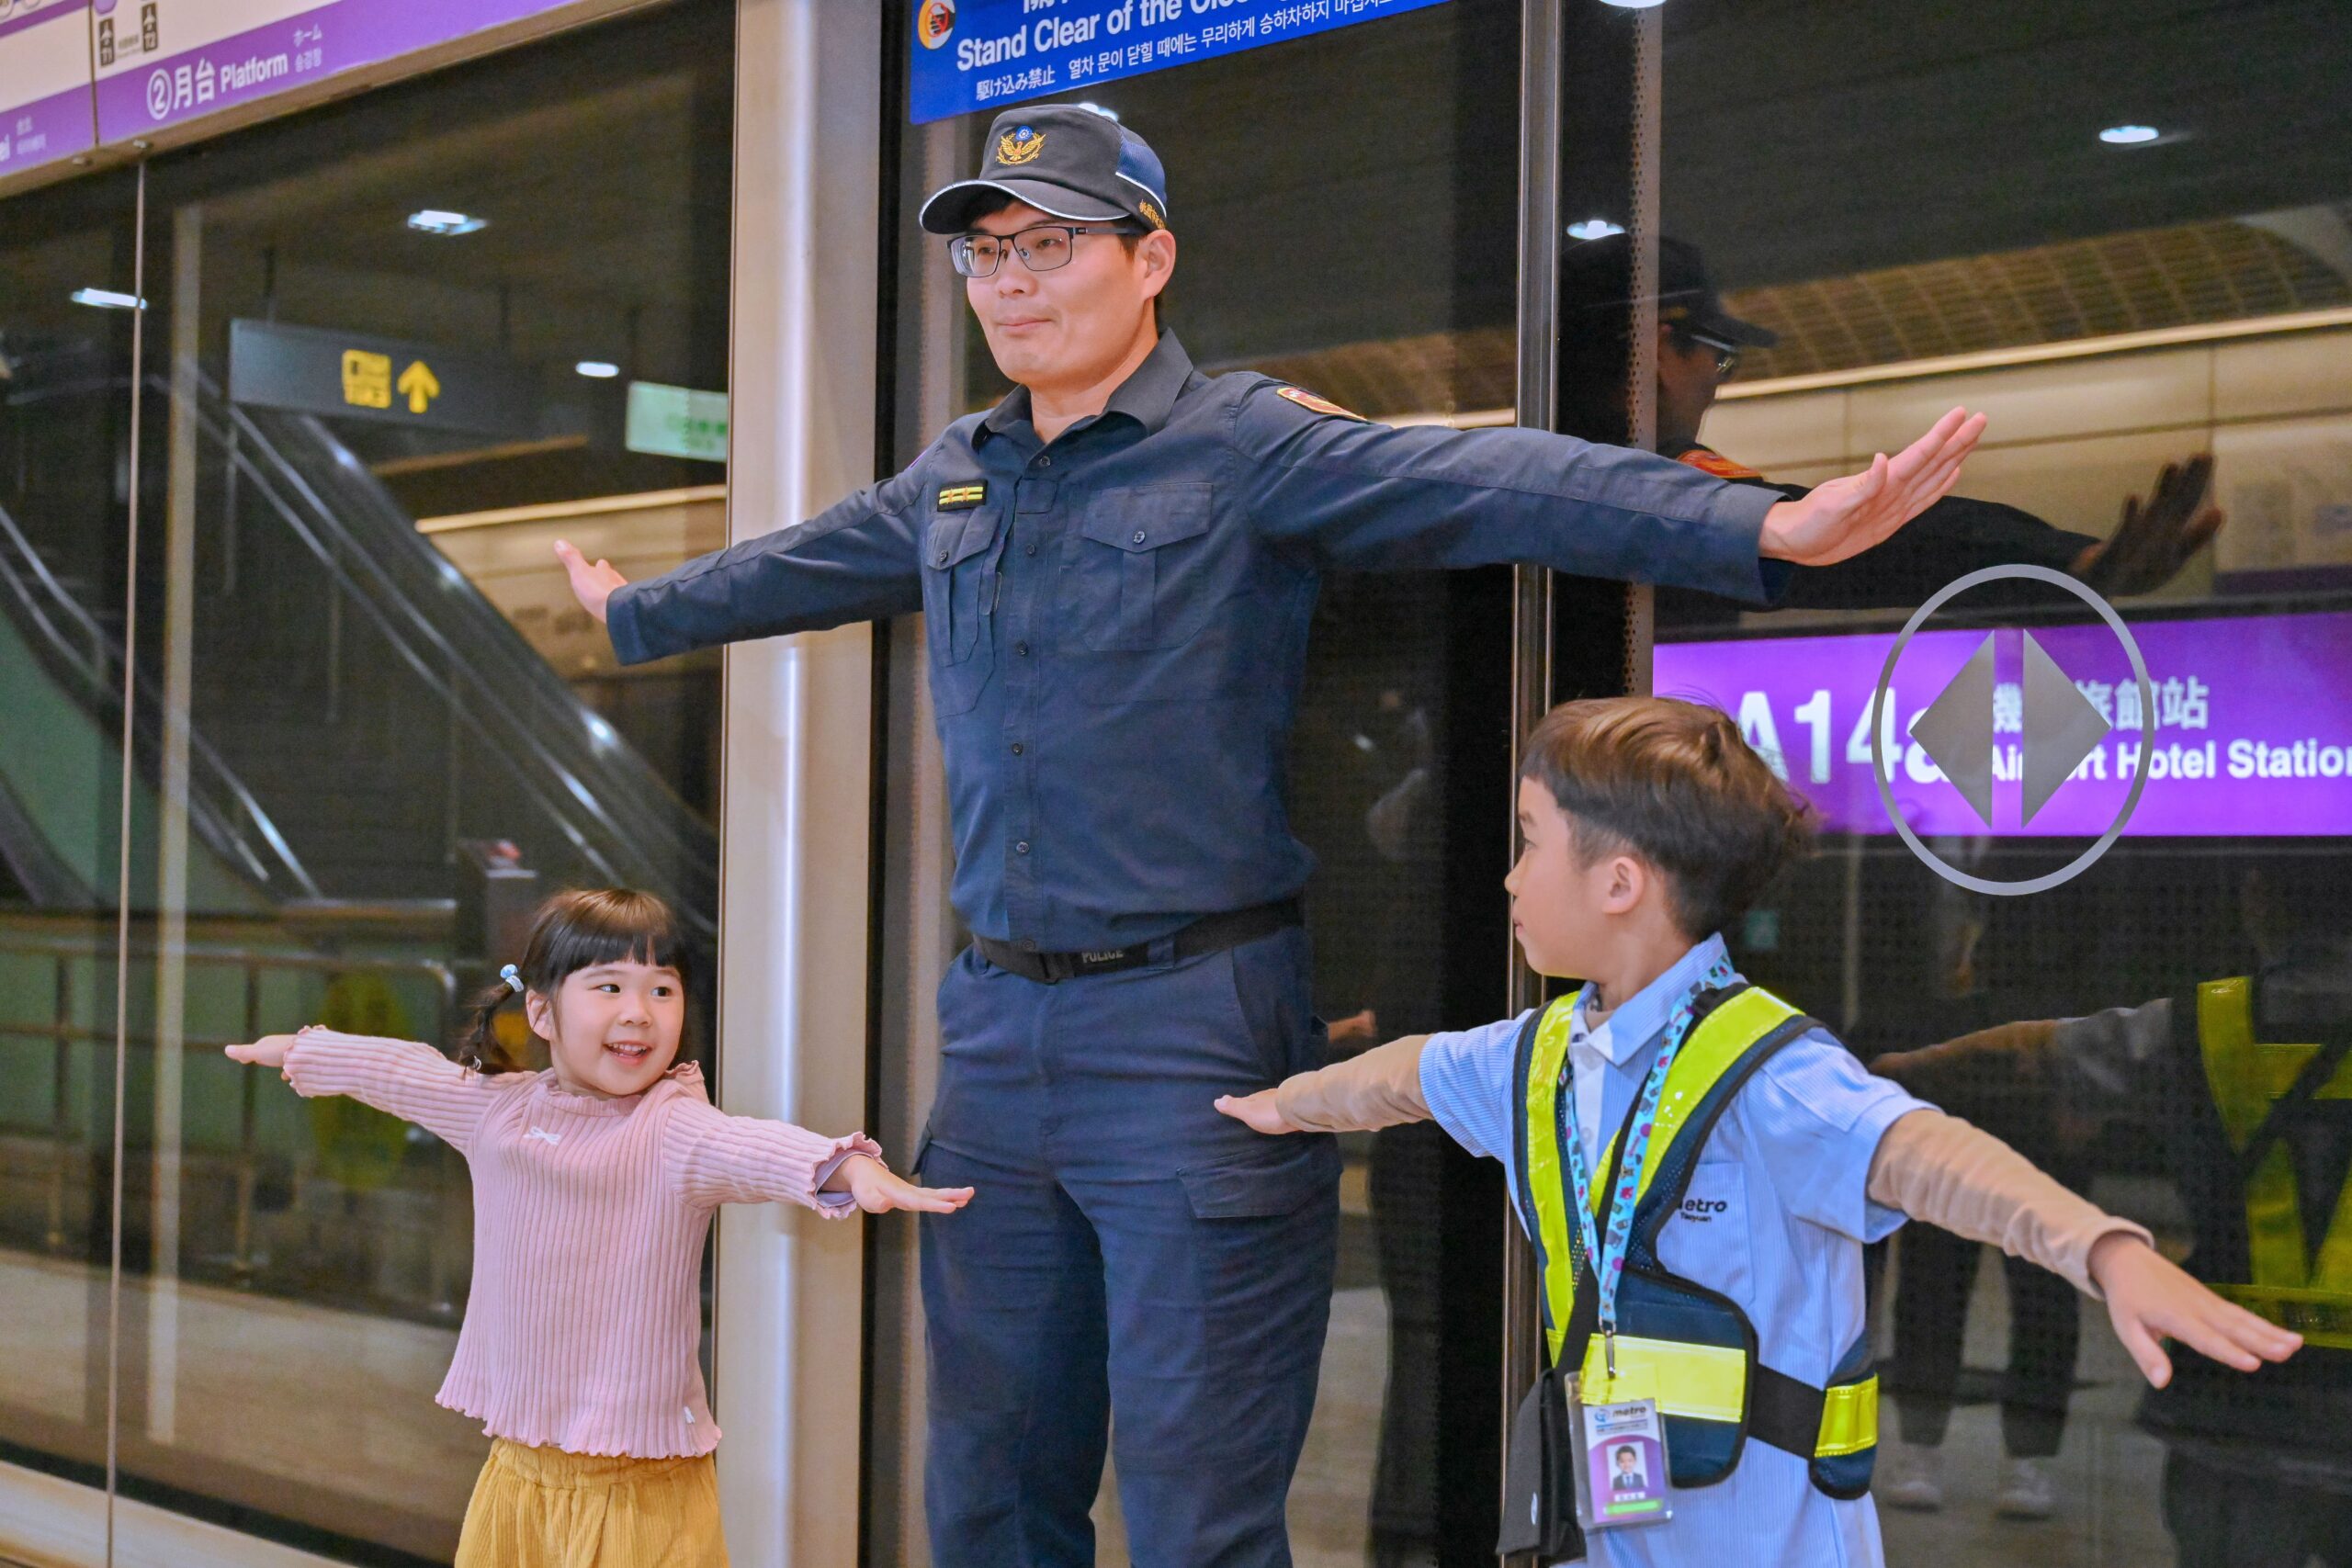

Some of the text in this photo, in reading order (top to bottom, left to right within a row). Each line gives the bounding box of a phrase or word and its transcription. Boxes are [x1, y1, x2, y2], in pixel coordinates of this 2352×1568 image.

[956, 0, 1182, 72] Stand Clear of the
[1069, 55, 1094, 80] 열차
[1098, 48, 1123, 73] 문이
[1127, 40, 1153, 66] 닫힐
[1157, 32, 1197, 58] 때에는
[1200, 17, 1255, 49] 무리하게
[1259, 0, 1329, 35] 승하차하지
[220, 52, 288, 93] Platform
[2116, 739, 2216, 780] Hotel
[1679, 1198, 1727, 1213] etro
